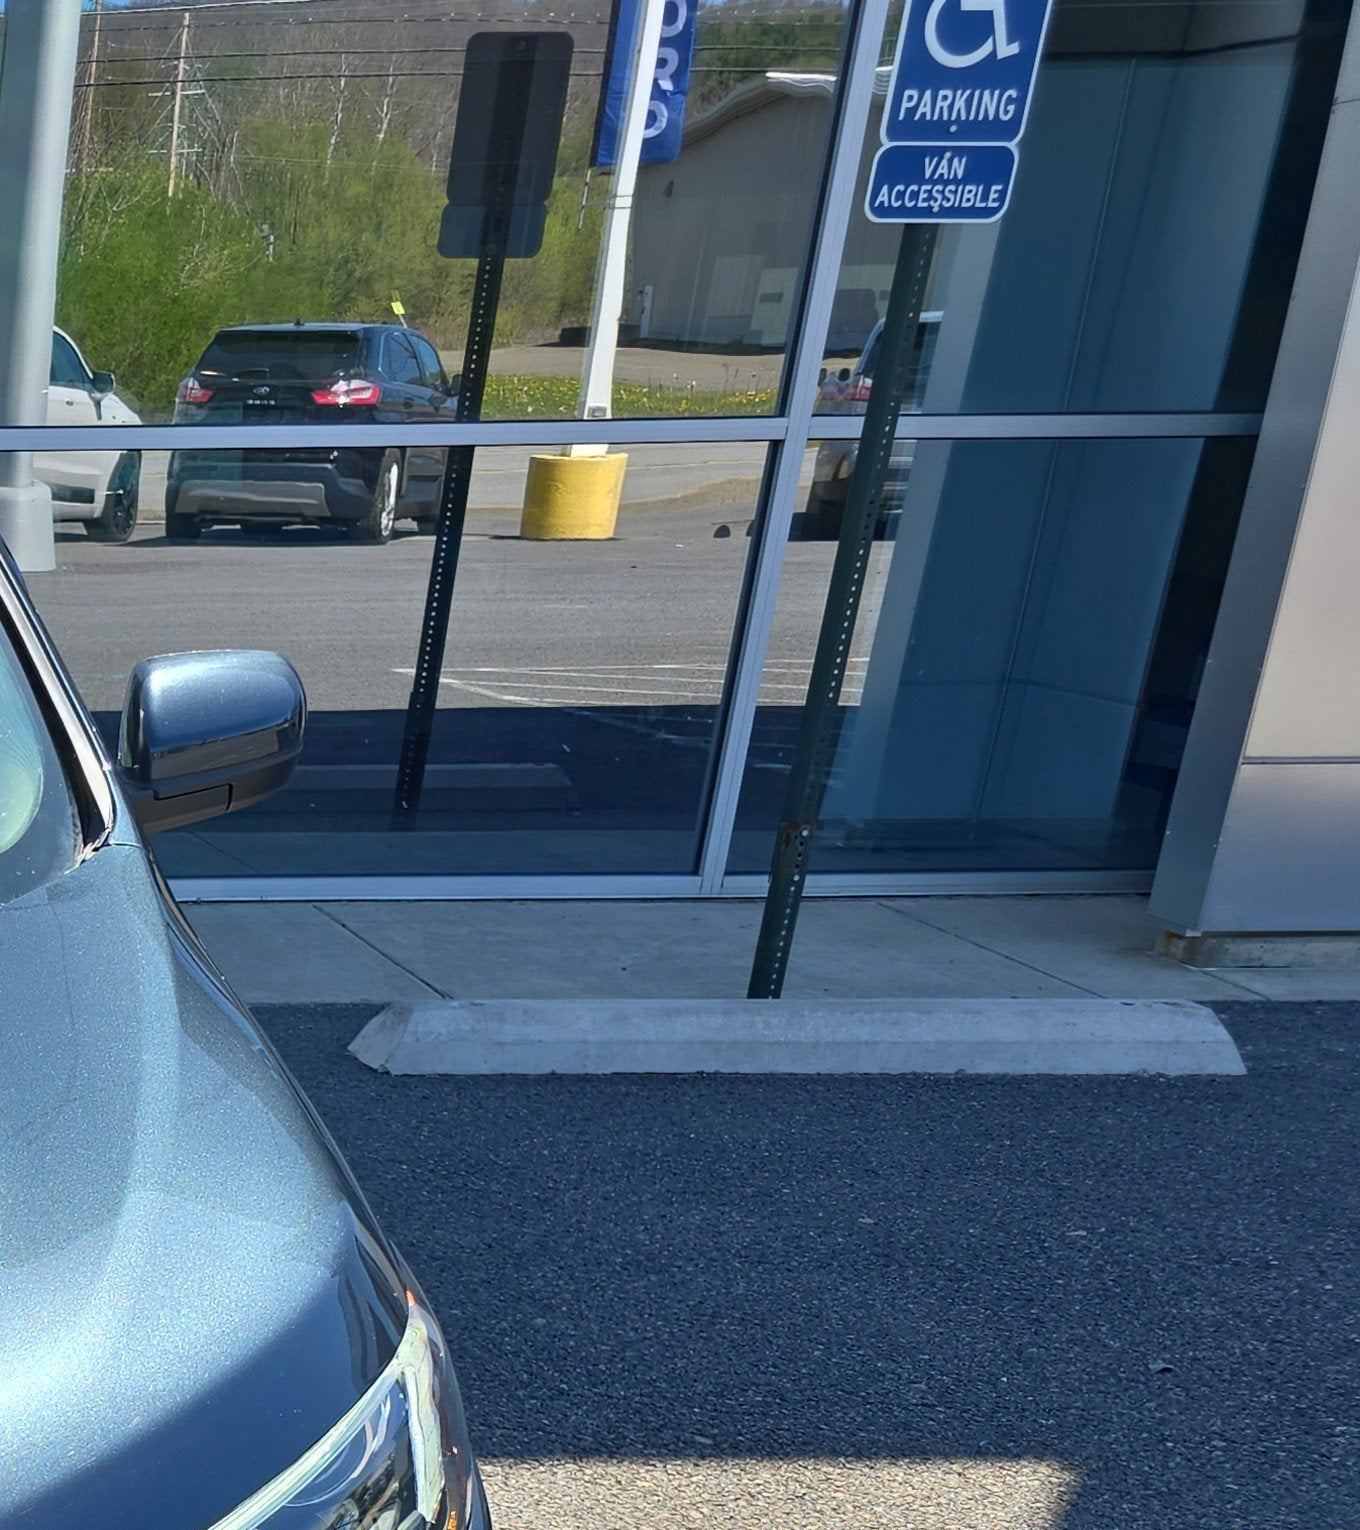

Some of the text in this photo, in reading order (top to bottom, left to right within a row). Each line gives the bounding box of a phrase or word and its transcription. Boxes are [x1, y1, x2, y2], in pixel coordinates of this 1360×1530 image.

[897, 89, 1018, 121] PARKING
[924, 155, 967, 180] VAN
[874, 184, 1003, 208] ACCESSIBLE
